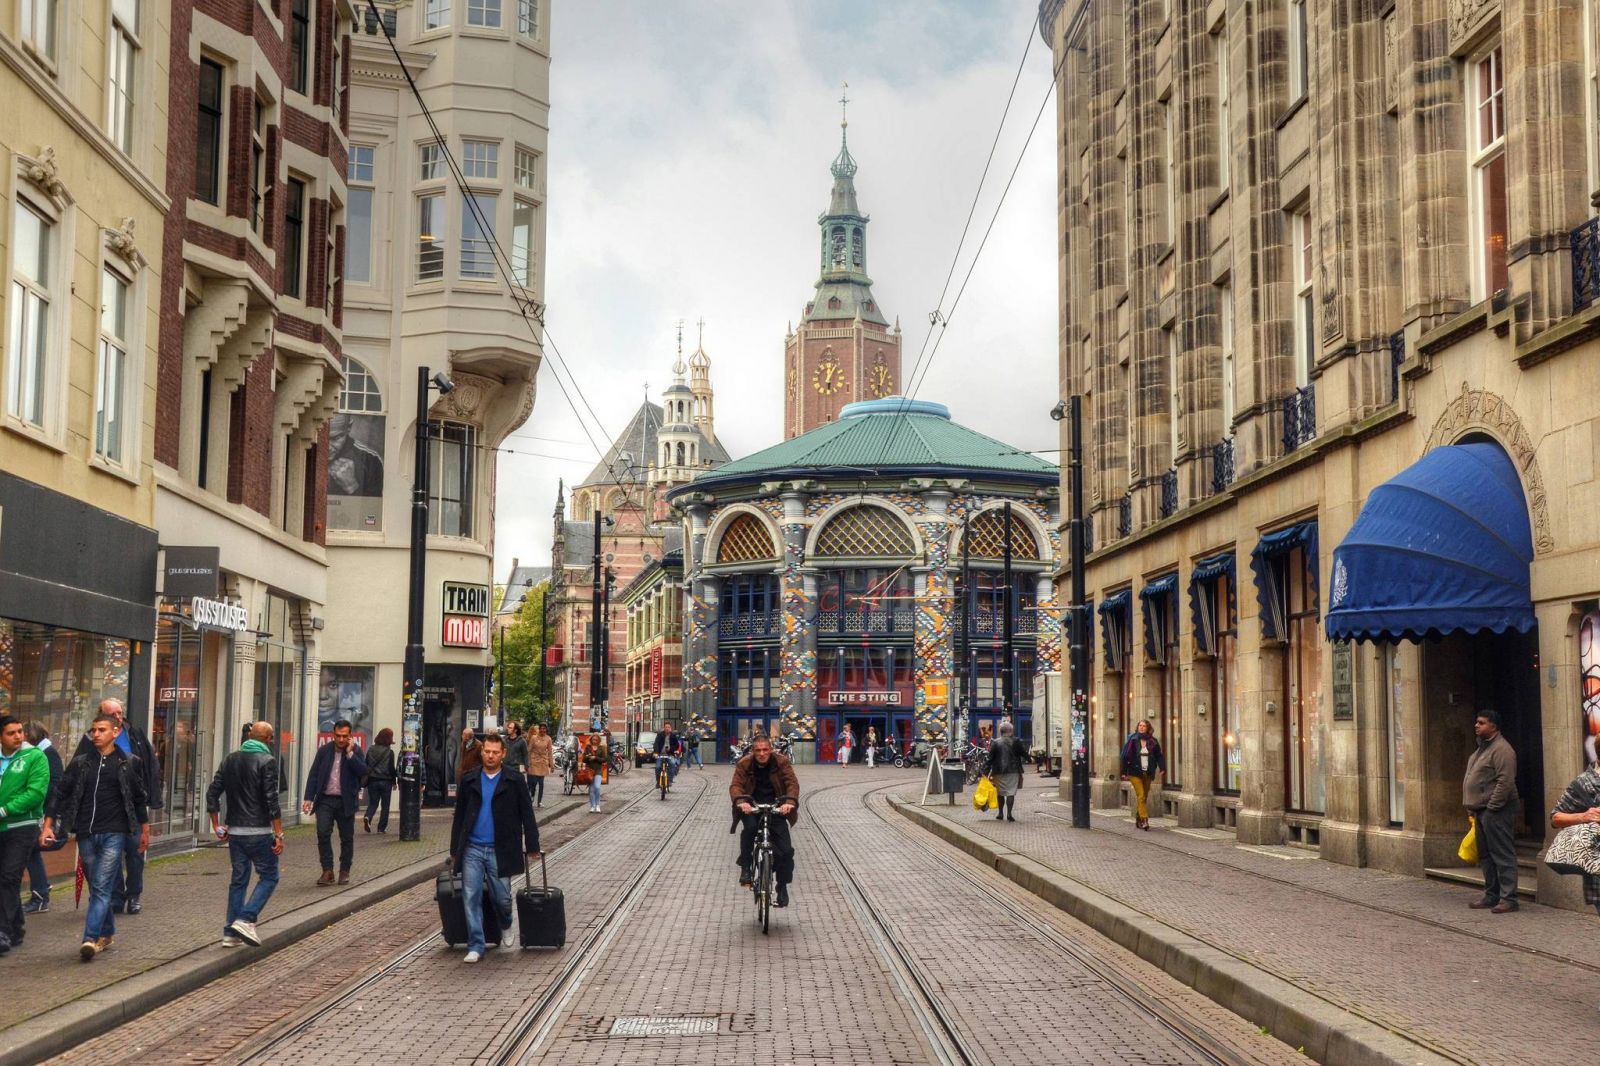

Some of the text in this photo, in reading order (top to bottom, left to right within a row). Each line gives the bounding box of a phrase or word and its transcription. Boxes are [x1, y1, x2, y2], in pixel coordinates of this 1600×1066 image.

[447, 586, 487, 613] TRAIN
[831, 694, 898, 702] THE STING
